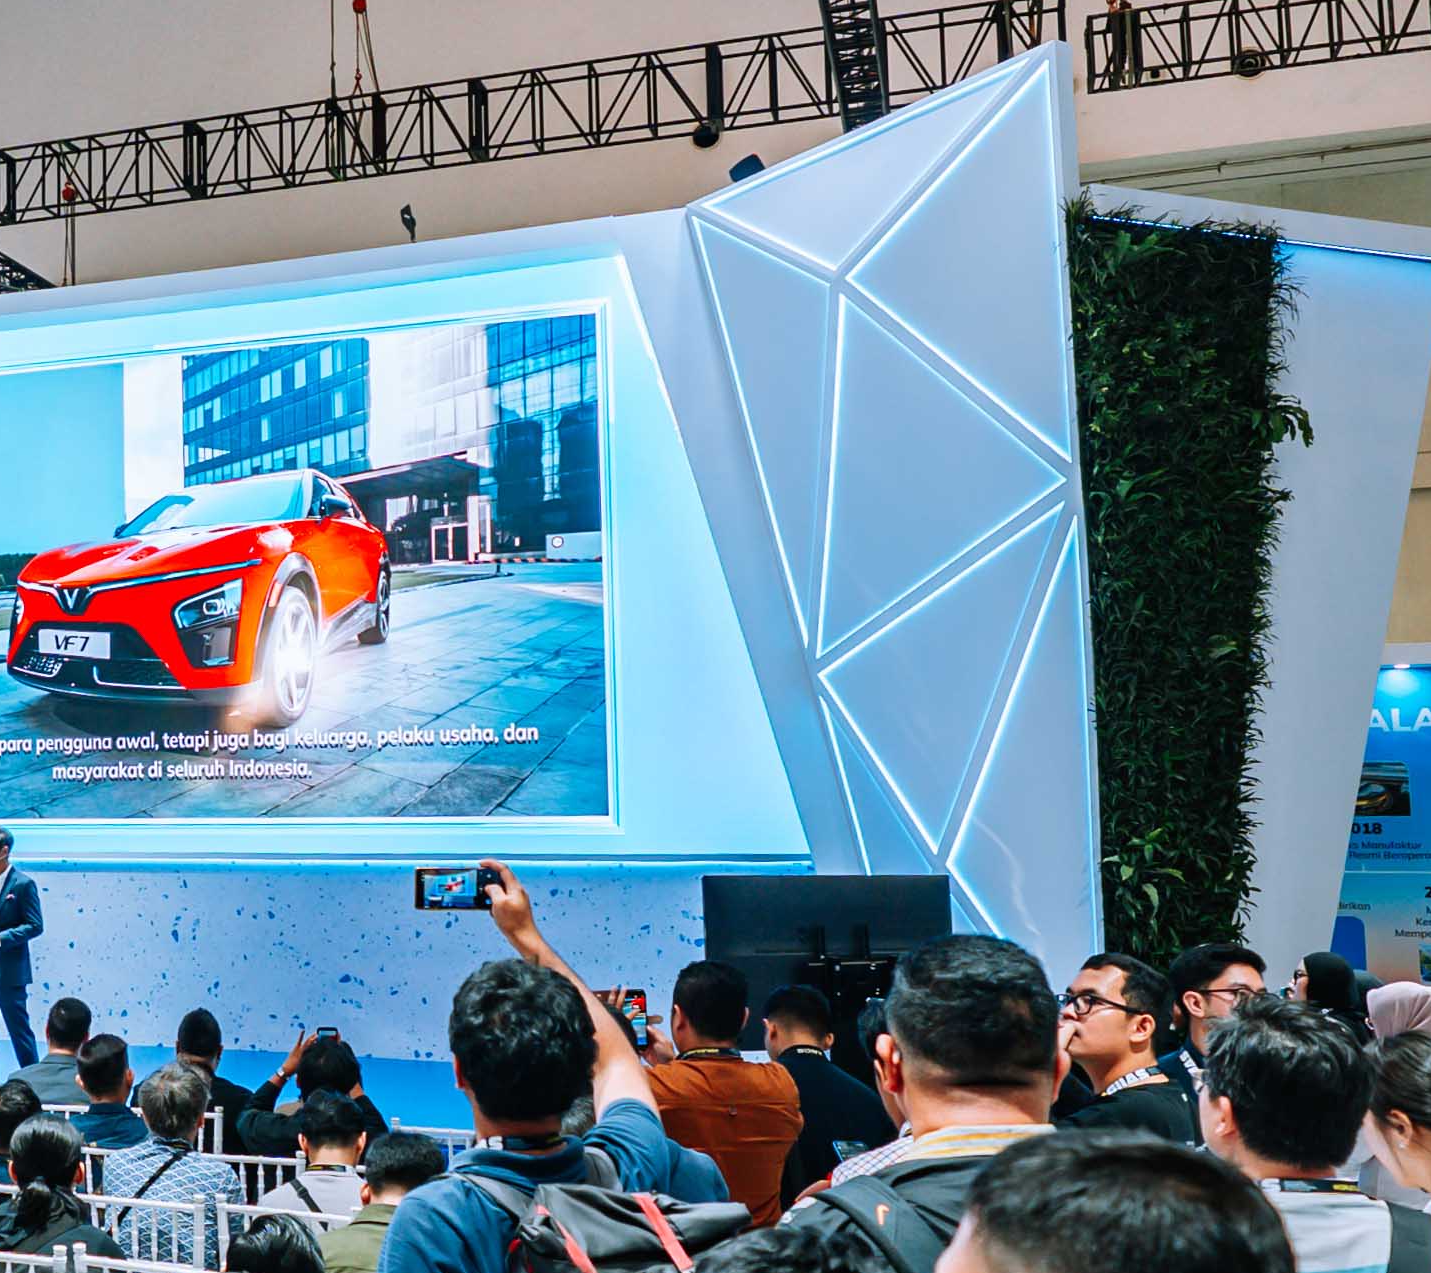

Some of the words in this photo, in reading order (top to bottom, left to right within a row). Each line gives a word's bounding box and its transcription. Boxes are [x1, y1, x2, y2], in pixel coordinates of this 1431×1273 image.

[36, 735, 112, 755] pengguna
[115, 731, 159, 752] awal,
[162, 730, 210, 754] tetapi
[211, 730, 249, 754] juga
[253, 729, 289, 754] bagi
[294, 728, 373, 753] keluarga,
[377, 725, 434, 751] pelaku
[439, 725, 499, 746] usaha,
[503, 722, 539, 743] dan
[52, 761, 144, 783] masyarakat
[147, 760, 163, 779] di
[166, 759, 226, 779] seluruh
[229, 758, 313, 779] Indonesia.
[1351, 822, 1383, 834] 018
[1361, 840, 1423, 849] Manufaktur
[1349, 850, 1382, 859] Resmi
